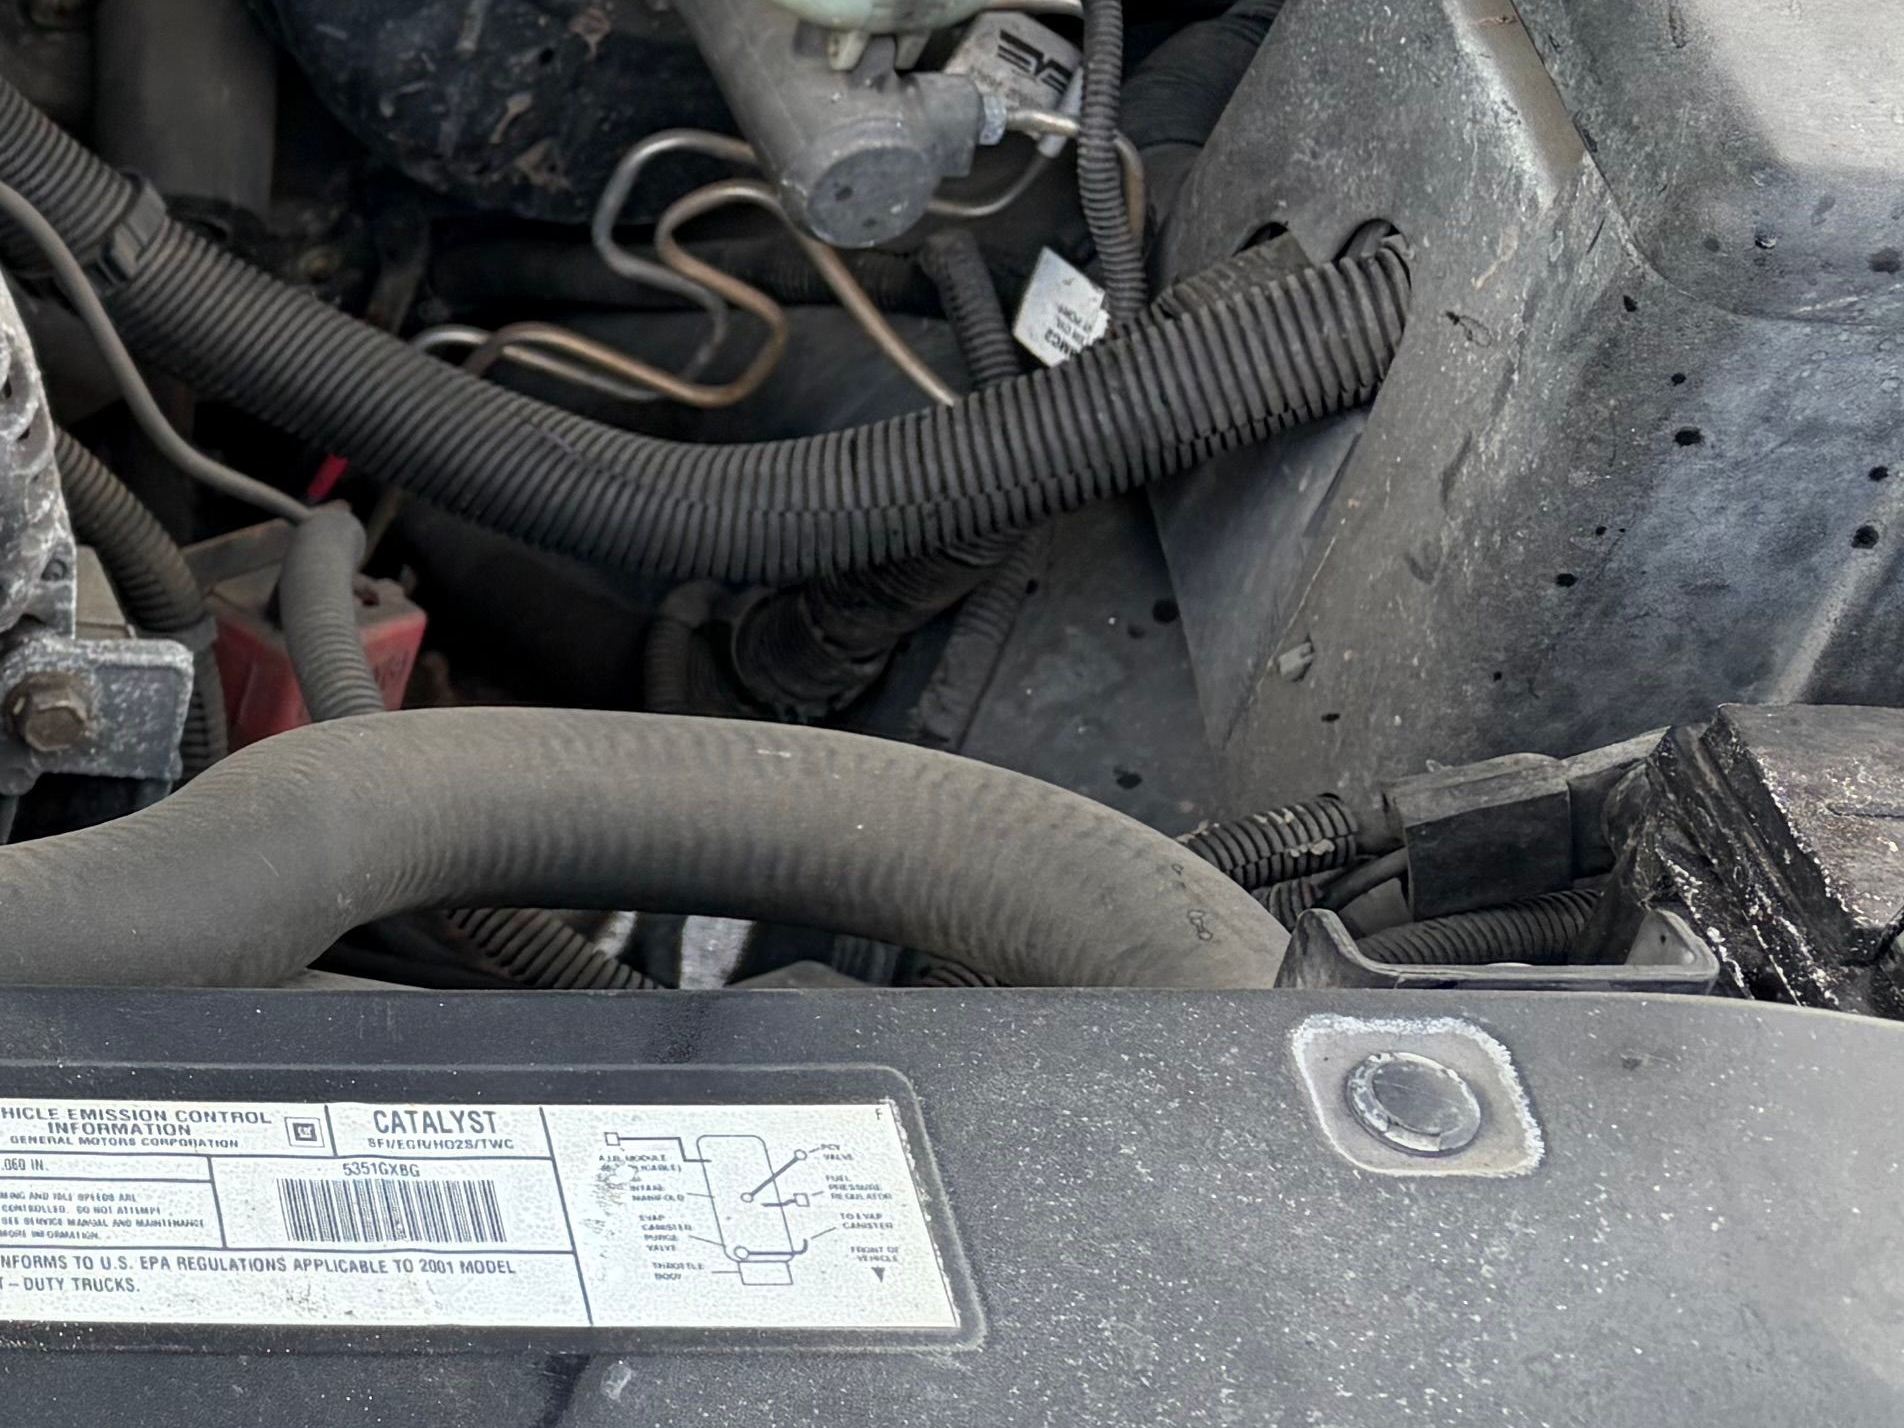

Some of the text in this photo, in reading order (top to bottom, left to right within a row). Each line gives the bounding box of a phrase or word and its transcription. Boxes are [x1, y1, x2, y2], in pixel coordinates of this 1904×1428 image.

[66, 1108, 168, 1124] EMISSION
[175, 1110, 273, 1125] CONTROL
[373, 1109, 498, 1135] CATALYST
[48, 1122, 192, 1137] INFORMATION
[9, 1134, 239, 1150] GENERAL MOTORS CORPORATION
[30, 1158, 51, 1172] IN.
[74, 1254, 94, 1271] TO
[100, 1254, 134, 1272] U.S.
[139, 1255, 172, 1272] EPA
[177, 1256, 287, 1273] REGULATIONS
[293, 1258, 389, 1274] APPLICABLE
[392, 1259, 414, 1274] TO
[419, 1259, 454, 1275] 2001
[460, 1260, 517, 1275] MODEL
[23, 1276, 66, 1292] DUTY
[72, 1277, 141, 1294] TRUCKS.
